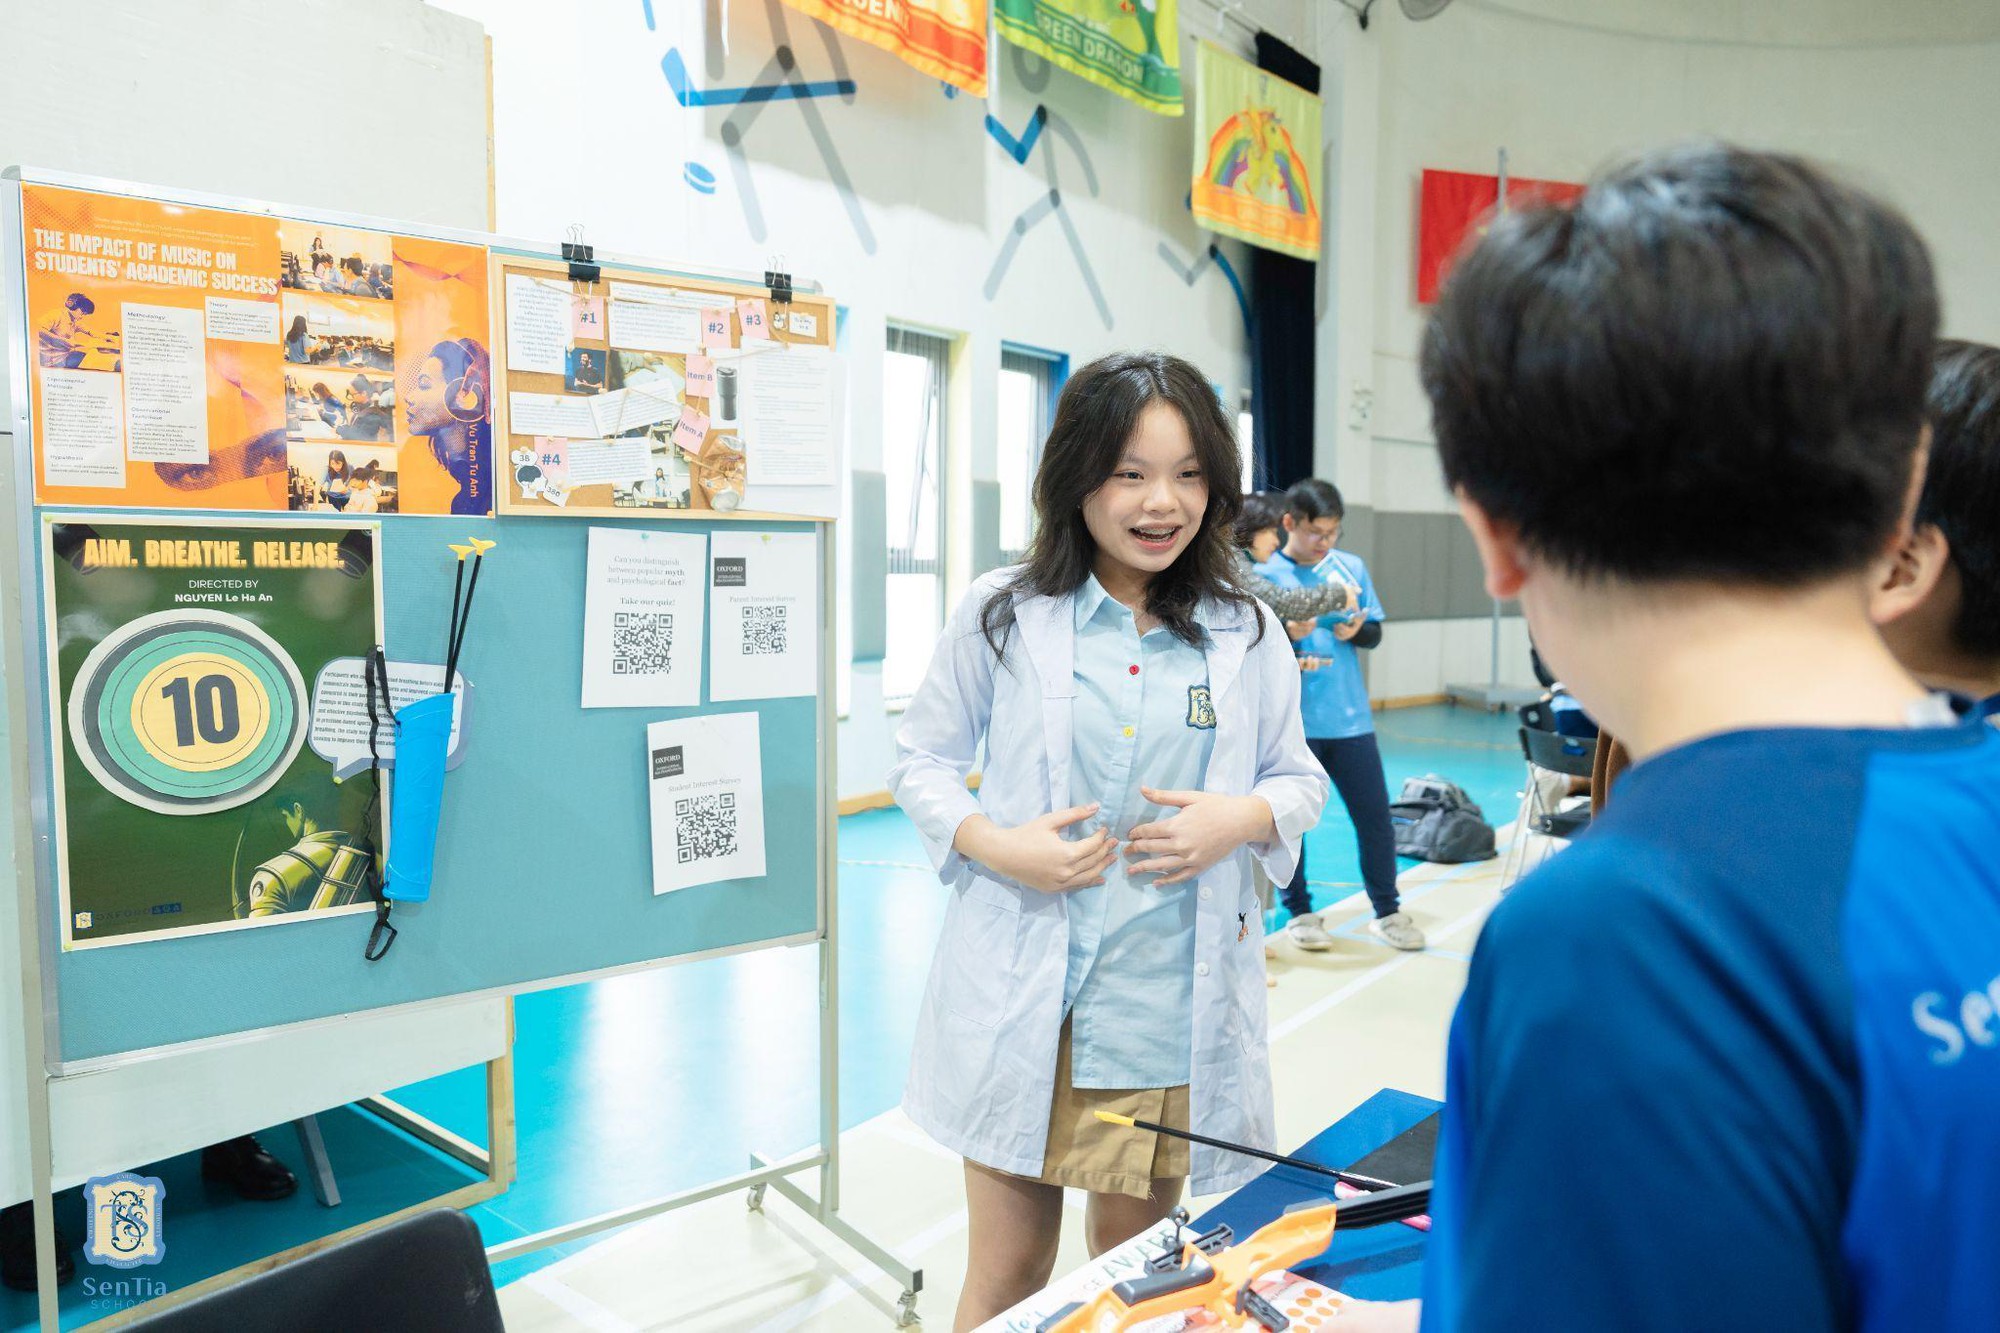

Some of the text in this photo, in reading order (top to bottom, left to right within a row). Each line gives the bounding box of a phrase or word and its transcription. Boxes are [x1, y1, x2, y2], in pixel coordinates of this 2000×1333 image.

[1083, 36, 1144, 83] DRAGON
[33, 228, 64, 250] THE
[69, 232, 132, 259] IMPACT
[137, 241, 157, 261] OF
[161, 244, 212, 266] MUSIC
[216, 252, 236, 270] ON
[34, 251, 279, 296] STUDENTS' ACADEMIC SUCCESS
[127, 311, 166, 321] Methodology
[580, 312, 597, 324] #1
[746, 314, 762, 326] #3
[708, 322, 724, 334] #2
[687, 371, 705, 379] Item
[680, 421, 703, 439] Item A
[469, 423, 479, 498] Vu Tran Tu Anh
[542, 453, 561, 466] #4
[83, 538, 345, 569] AIM. BREATHE. RELEASE.
[614, 555, 680, 566] Can you distinguish
[608, 564, 685, 577] between popular myth
[188, 579, 259, 589] DIRECTED BY
[621, 577, 666, 587] psychological
[667, 578, 686, 586] fact?
[174, 593, 273, 603] NGUYEN Le Ha An
[620, 597, 640, 605] Take
[656, 598, 676, 607] quiz!
[729, 595, 797, 604] Parent Interest Survey
[161, 674, 240, 748] 10
[655, 754, 681, 764] OXFORD
[668, 777, 742, 792] Student Interest Survey
